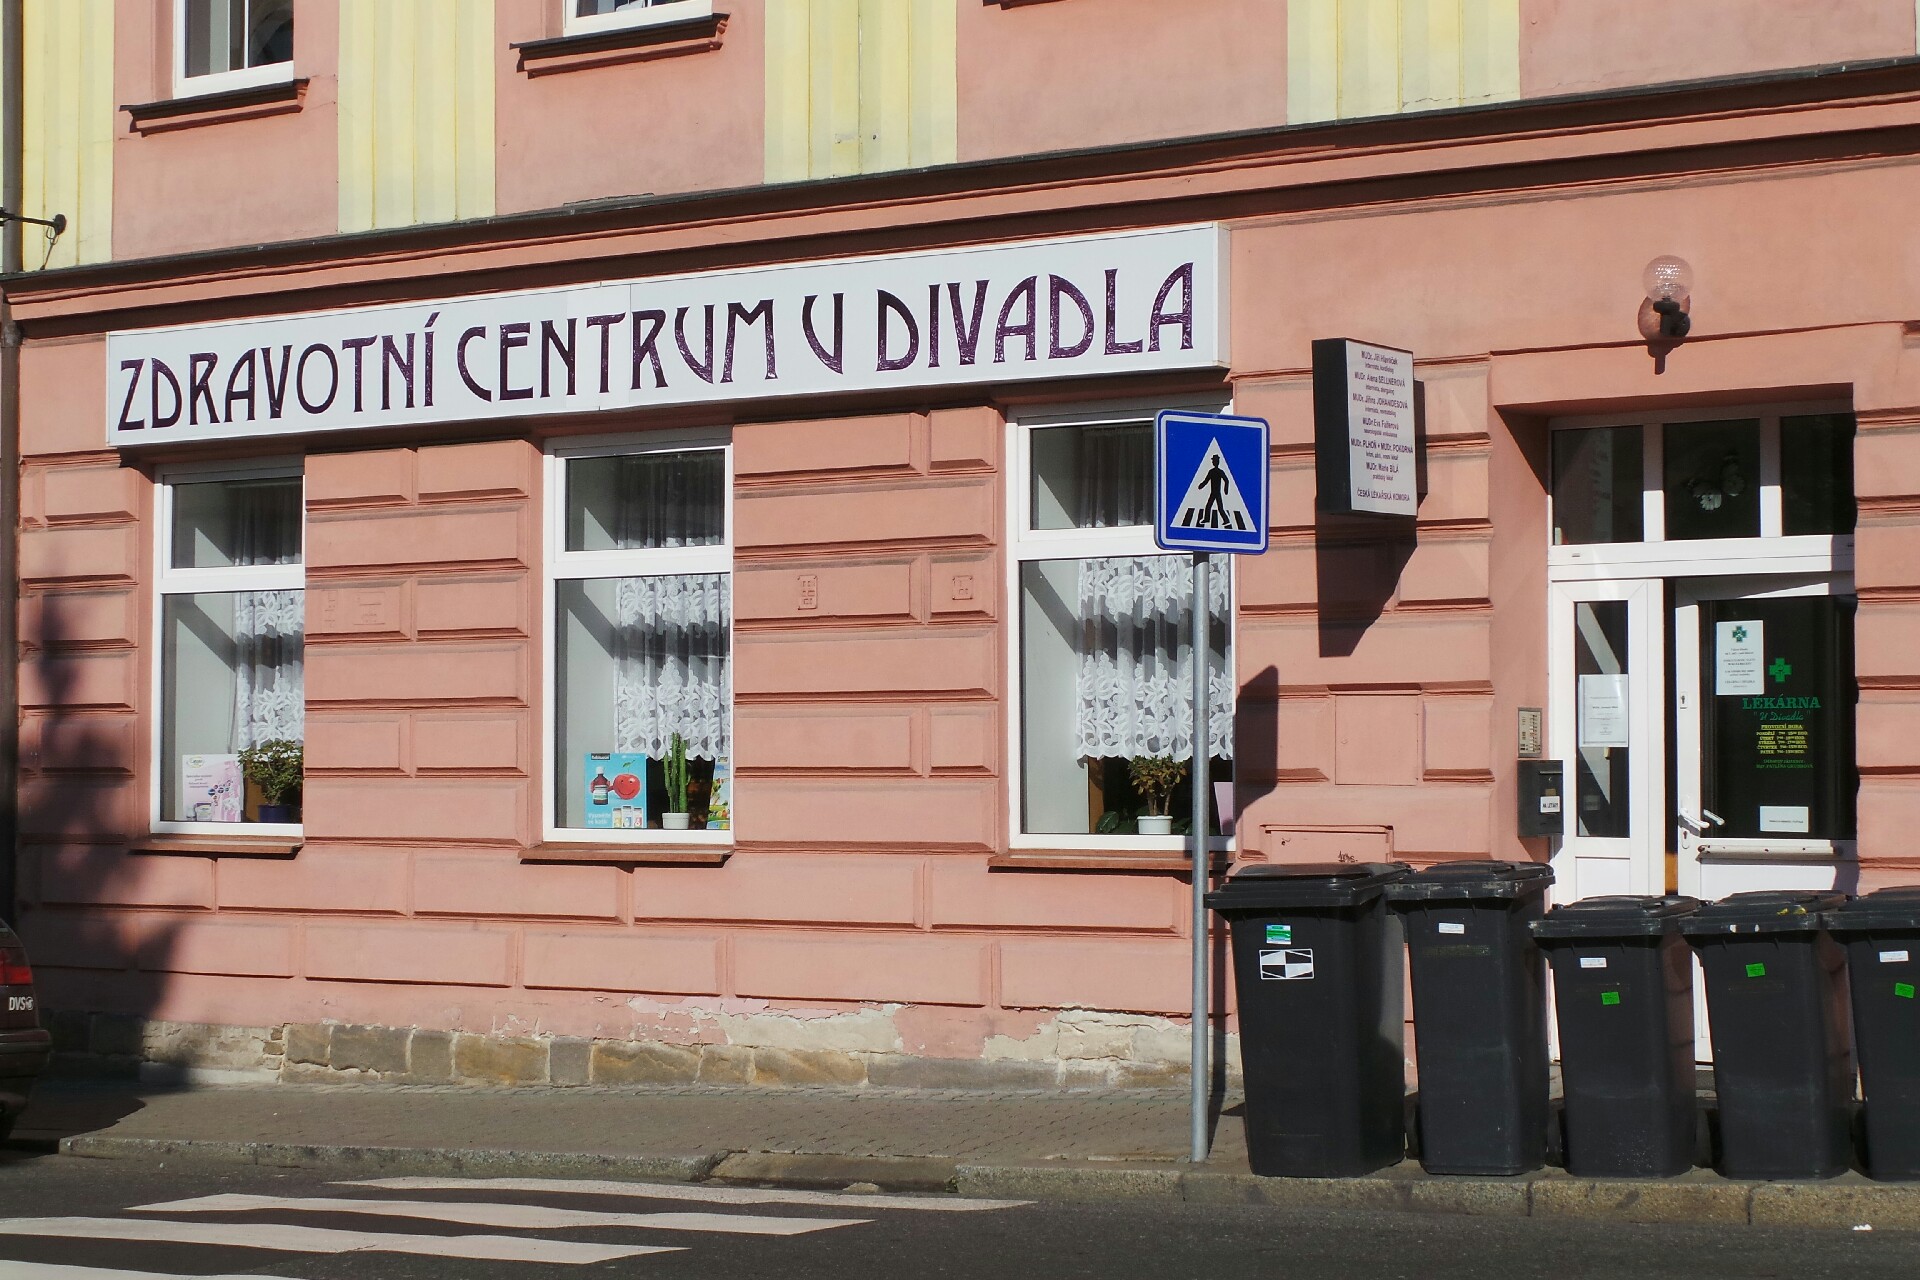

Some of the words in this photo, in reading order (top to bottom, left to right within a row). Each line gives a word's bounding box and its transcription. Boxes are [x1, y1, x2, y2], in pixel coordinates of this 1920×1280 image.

[118, 312, 440, 431] ZDRAVOTNÍ
[457, 299, 778, 402] CENTRUM
[801, 293, 844, 375] U
[876, 262, 1194, 372] DIVADLA
[1742, 694, 1821, 709] LÉKÁRNA
